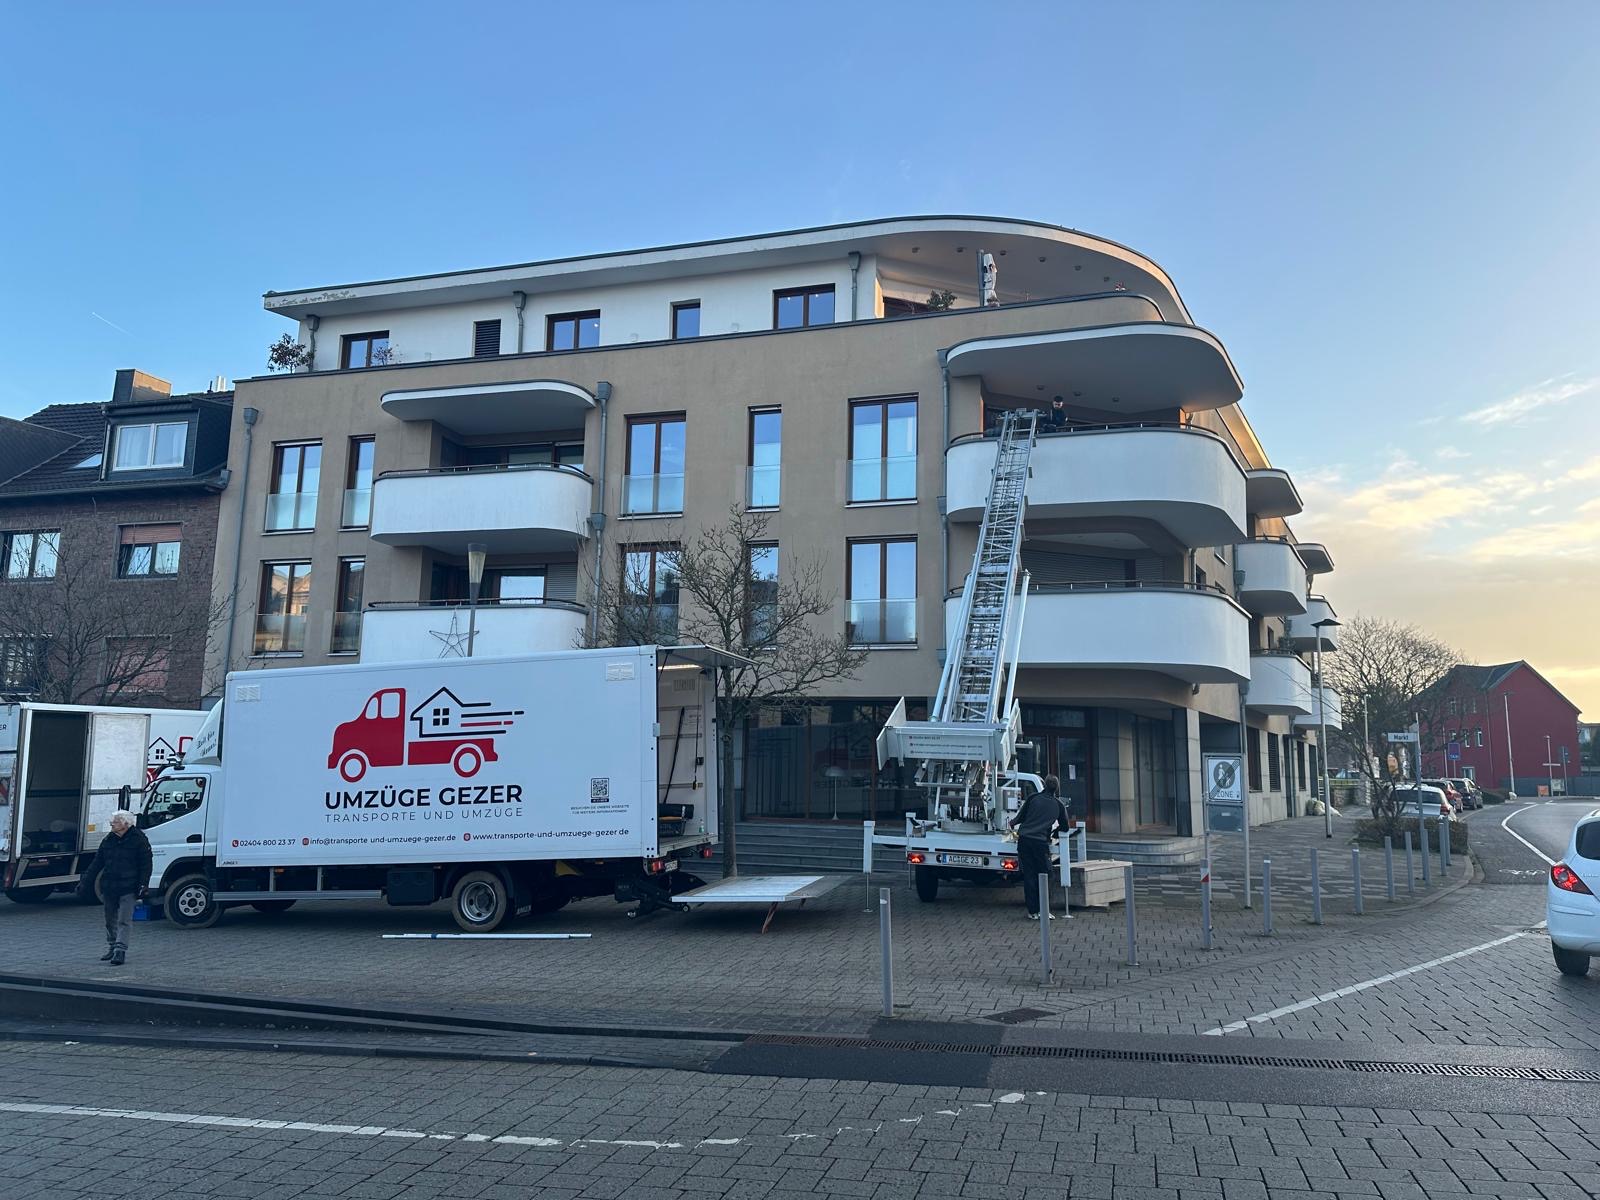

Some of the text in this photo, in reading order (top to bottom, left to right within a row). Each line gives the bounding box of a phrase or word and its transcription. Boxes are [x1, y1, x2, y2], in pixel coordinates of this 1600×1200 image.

[325, 784, 523, 810] UMZÜGE GEZER
[325, 807, 523, 823] TRANSPORTE UND UMZÜGE
[310, 834, 456, 846] info@transporteund-umzuege-gezer.de
[473, 829, 629, 840] www.transporte-und-umzuege-gezerde
[240, 839, 262, 847] 02404
[263, 839, 277, 847] 800
